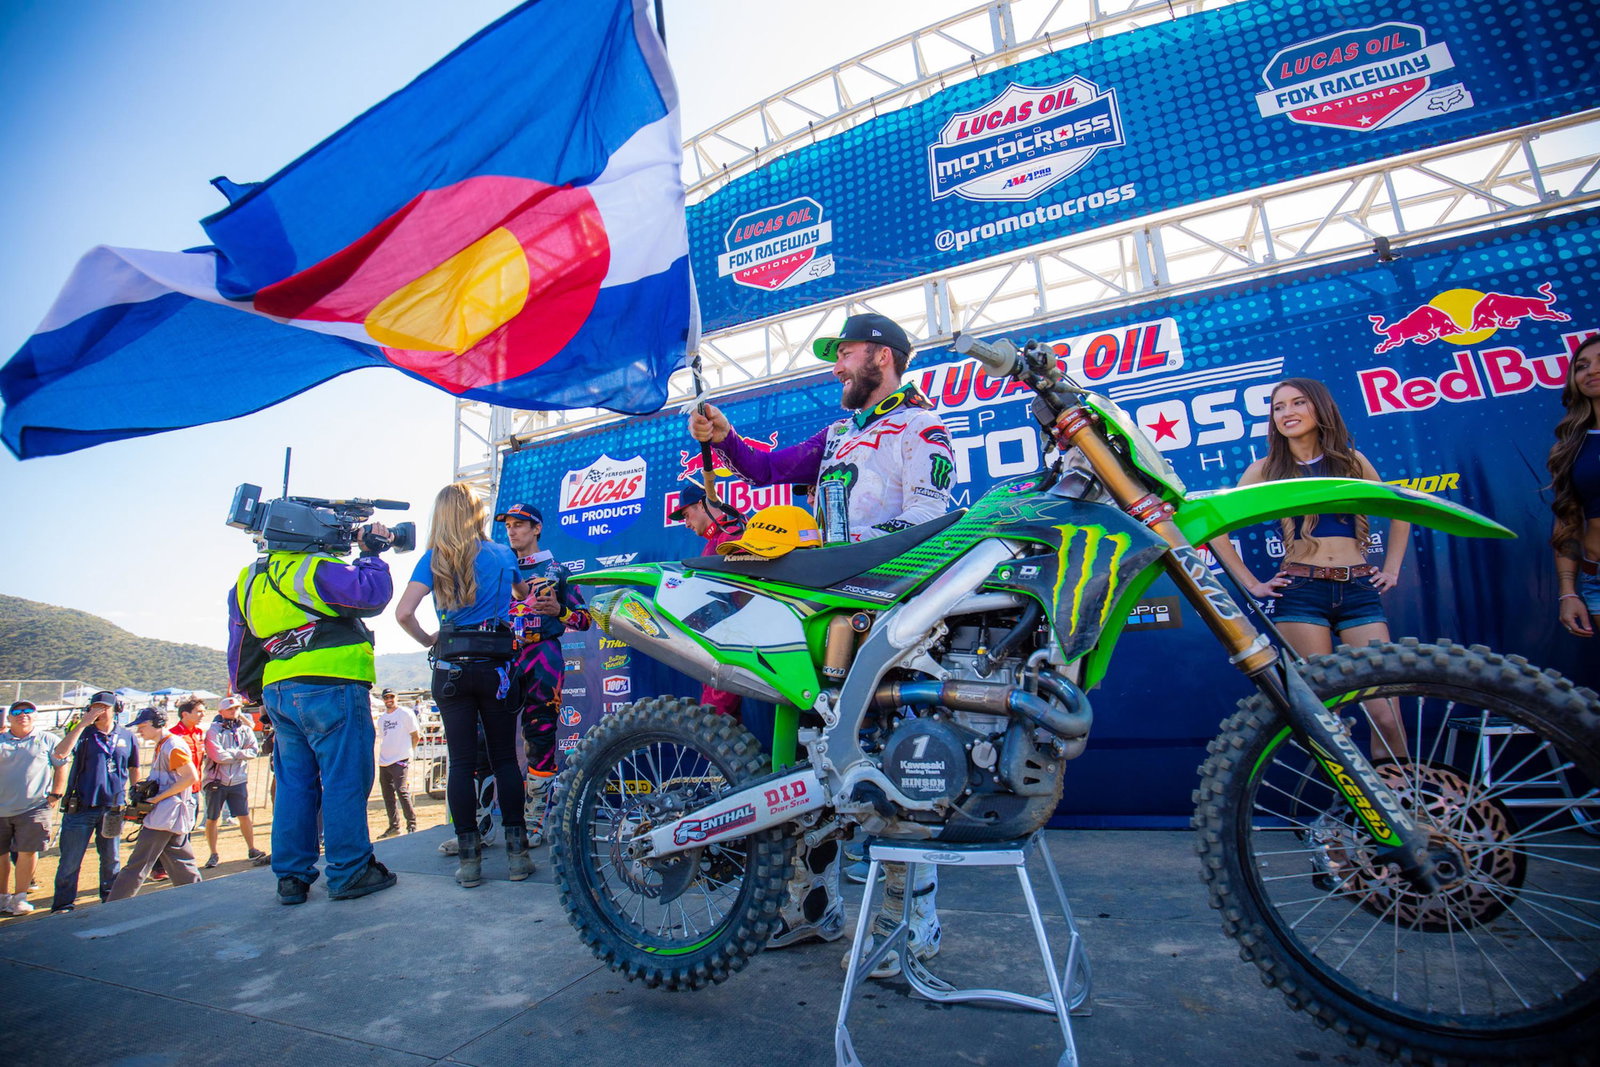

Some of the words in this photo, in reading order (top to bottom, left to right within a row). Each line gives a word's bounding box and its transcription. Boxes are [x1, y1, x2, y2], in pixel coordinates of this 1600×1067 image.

[1280, 43, 1360, 79] LUCAS
[1365, 33, 1406, 55] OIL
[1275, 84, 1315, 108] FOX
[1320, 53, 1431, 97] RACEWAY
[956, 101, 1034, 140] LUCAS
[1038, 87, 1078, 114] OIL
[1306, 85, 1413, 116] NATIONAL
[938, 113, 1111, 177] MOTOCROSS
[997, 126, 1041, 143] PRO
[939, 127, 1112, 184] CHAMPIONSHIP
[1001, 172, 1034, 190] AMA
[1034, 167, 1052, 177] PRO
[734, 215, 784, 243] LUCAS
[786, 207, 811, 226] OIL
[935, 183, 1137, 251] @promotocross
[728, 249, 753, 269] FOX
[755, 229, 820, 261] RACEWAY
[743, 254, 806, 278] NATIONAL
[1083, 324, 1170, 381] OIL
[1357, 350, 1486, 416] Red
[566, 475, 643, 509] LUCAS
[728, 480, 793, 516] Bull
[561, 514, 579, 526] OIL
[581, 503, 642, 522] PRODUCTS
[588, 524, 612, 536] INC.
[595, 552, 639, 565] FLY
[1170, 545, 1243, 620] KYB
[607, 680, 628, 692] 100%
[912, 734, 930, 759] 1
[900, 760, 945, 770] Kawasaki
[1314, 712, 1414, 831] DUNLOP
[764, 780, 807, 807] D.I.D
[901, 777, 946, 789] HINSON
